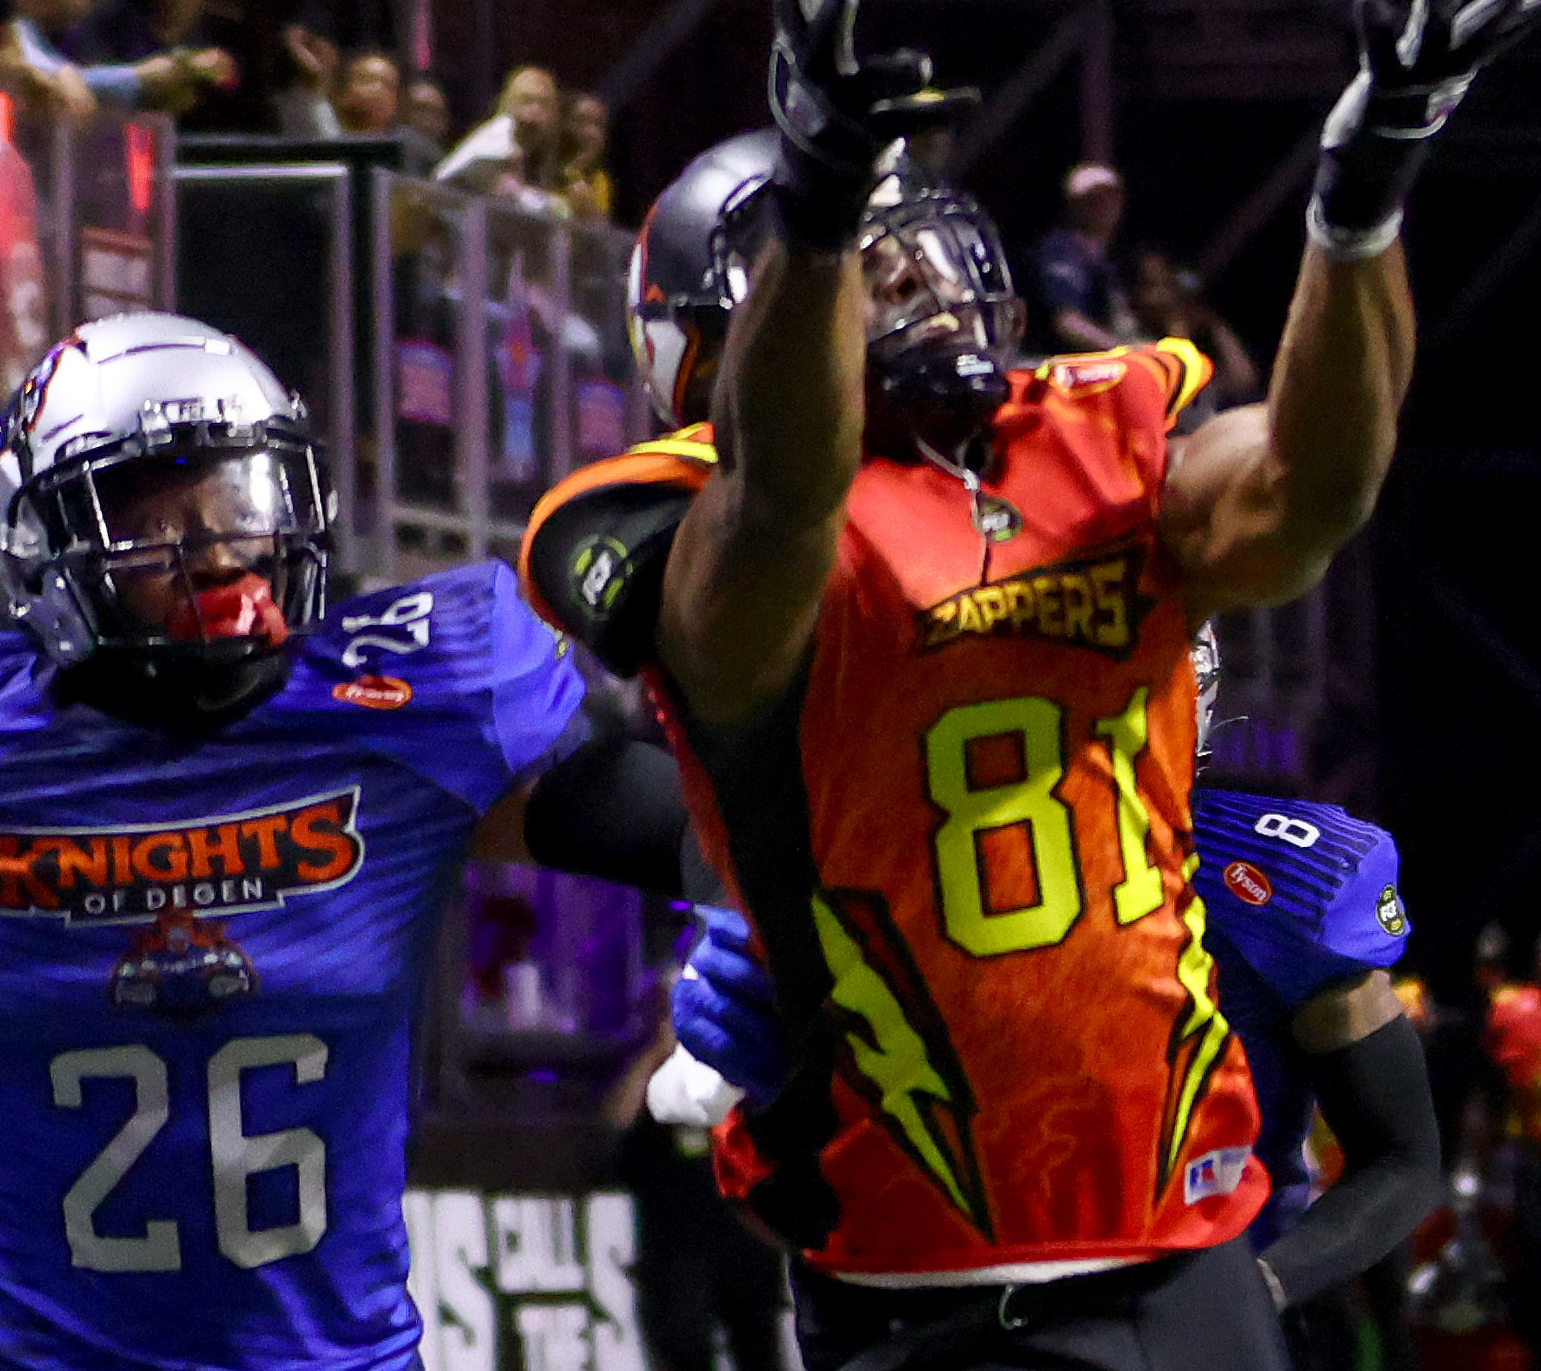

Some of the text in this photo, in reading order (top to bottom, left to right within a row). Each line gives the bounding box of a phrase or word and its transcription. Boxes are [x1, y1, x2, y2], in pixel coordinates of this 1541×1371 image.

[340, 591, 434, 668] 26
[925, 560, 1130, 648] ZAPPERS
[925, 685, 1165, 958] 81
[1254, 813, 1321, 848] 8
[84, 877, 263, 916] OF DEGEN
[1229, 862, 1268, 902] Tyson
[49, 1033, 329, 1272] 26
